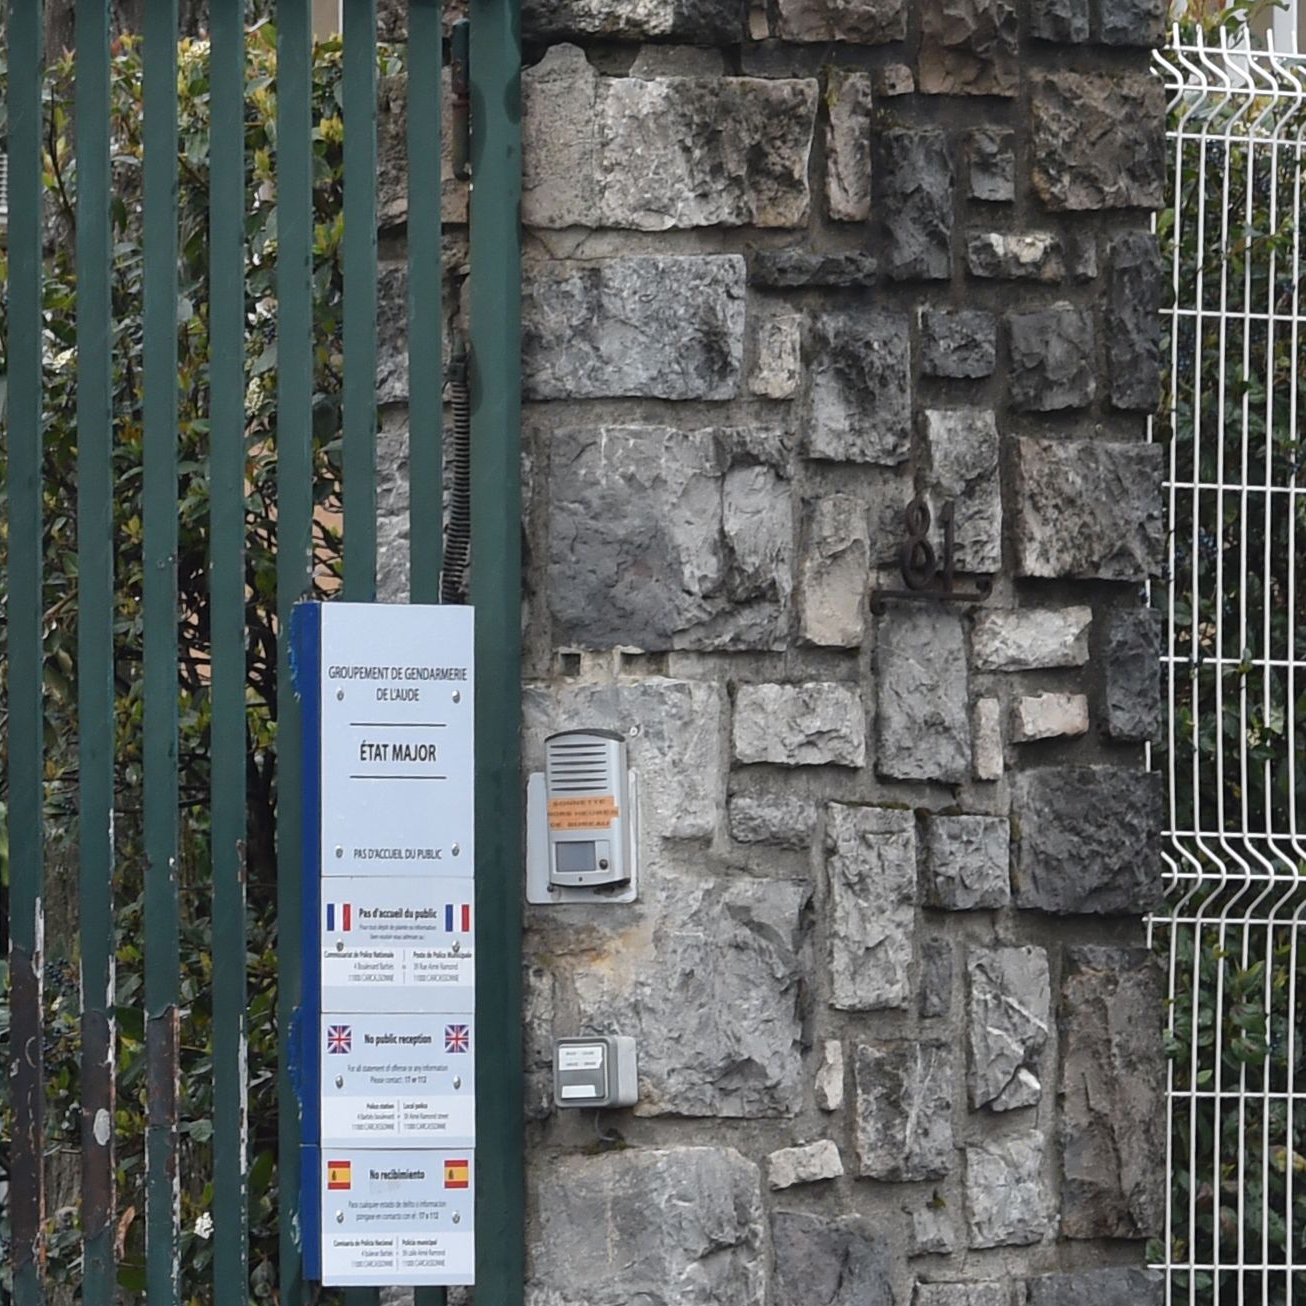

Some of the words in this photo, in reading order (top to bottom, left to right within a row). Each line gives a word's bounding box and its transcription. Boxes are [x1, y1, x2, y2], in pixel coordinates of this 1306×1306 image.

[329, 666, 389, 680] GROUPEMENT
[391, 667, 403, 680] DE
[404, 667, 468, 681] GENDARMERIE
[376, 688, 388, 701] DE
[390, 688, 420, 701] L'AUDE
[360, 739, 389, 762] ÉTAT
[392, 744, 436, 762] MAJOR
[354, 848, 367, 860] PAS
[367, 848, 404, 860] D'ACCUEIL
[405, 848, 416, 860] DU
[417, 848, 443, 860] PUBLIC
[359, 907, 372, 919] Pas
[372, 907, 404, 919] d'accueil
[404, 907, 414, 919] du
[414, 907, 438, 921] public
[364, 1034, 375, 1045] No
[375, 1034, 397, 1046] public
[398, 1034, 432, 1046] reception
[369, 1169, 380, 1180] No
[380, 1168, 425, 1180] recibimiento
